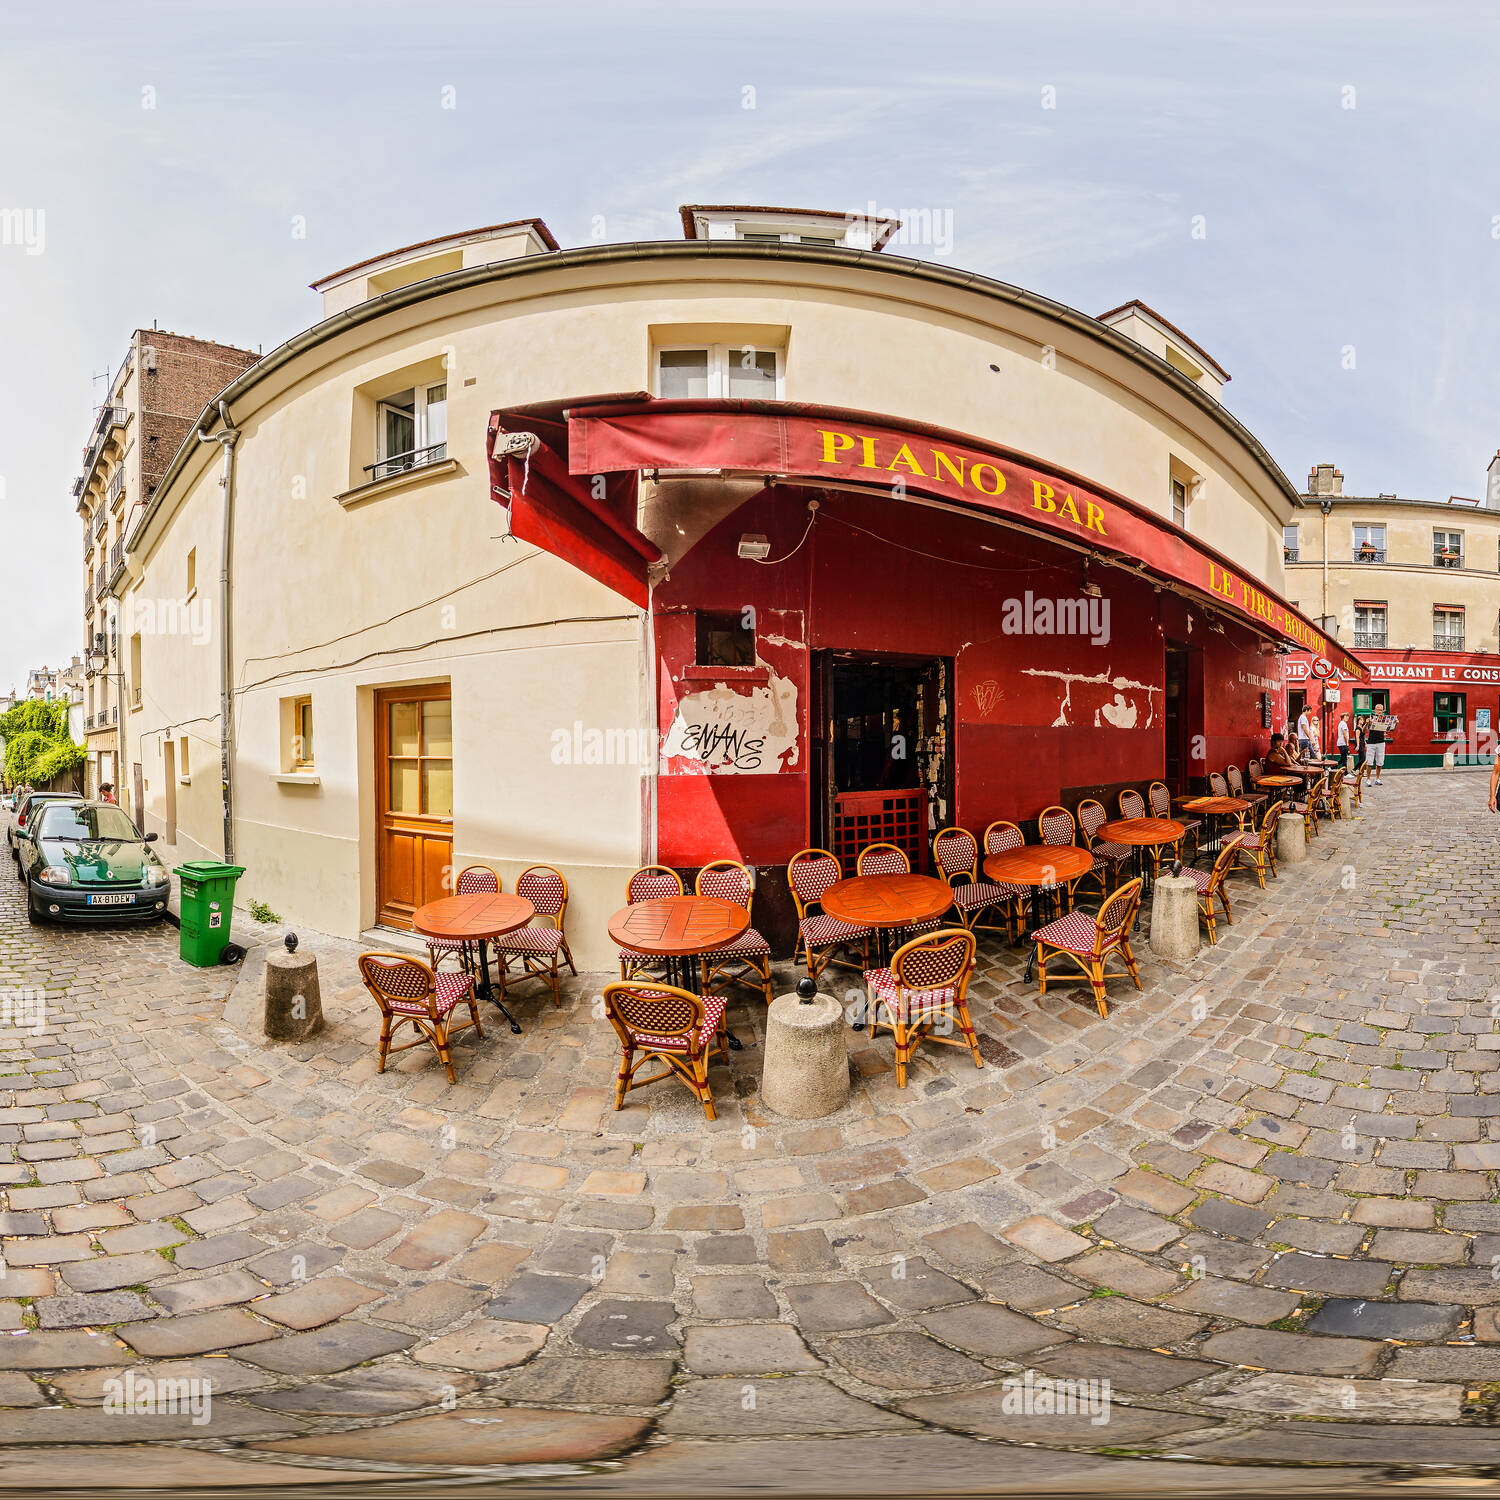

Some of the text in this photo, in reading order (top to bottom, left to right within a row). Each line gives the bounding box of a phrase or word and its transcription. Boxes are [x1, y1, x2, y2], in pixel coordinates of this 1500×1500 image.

[816, 429, 1108, 536] PIANO BAR
[1208, 562, 1235, 599] LE
[1240, 581, 1275, 624] TIRE
[1284, 611, 1327, 657] BOUCHON
[1343, 665, 1434, 679] TAURANT
[1442, 667, 1456, 679] LE
